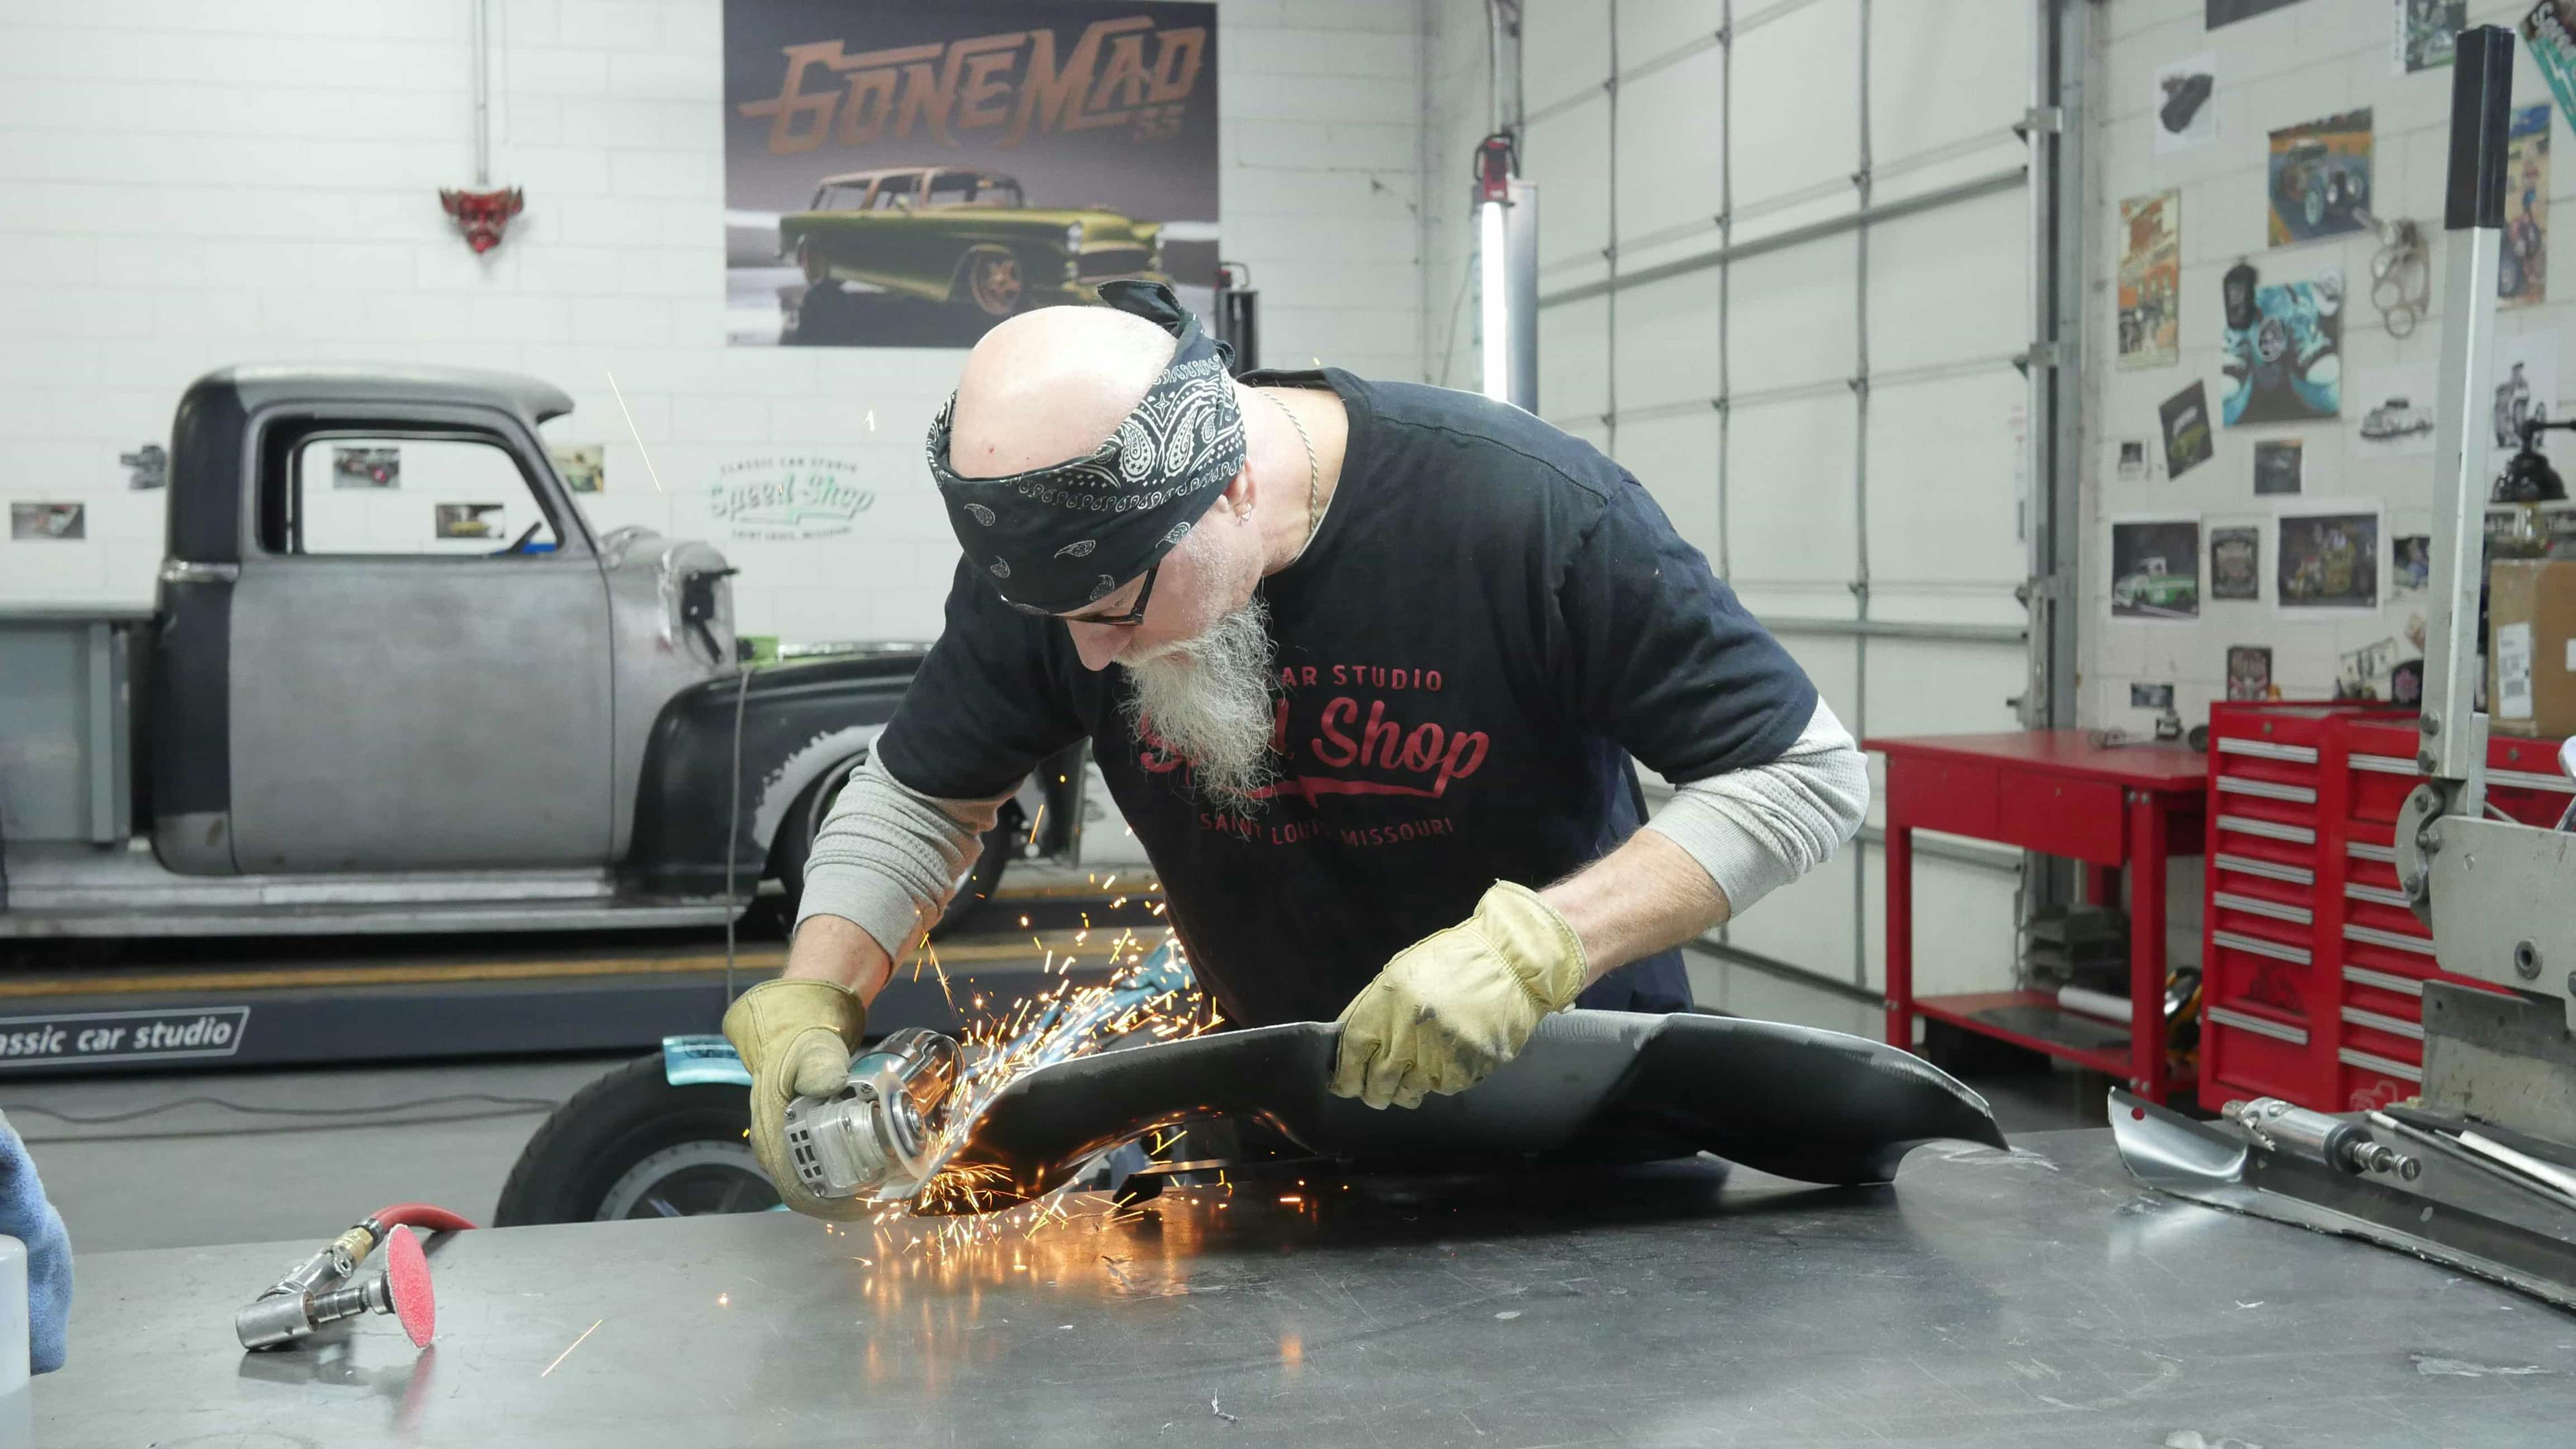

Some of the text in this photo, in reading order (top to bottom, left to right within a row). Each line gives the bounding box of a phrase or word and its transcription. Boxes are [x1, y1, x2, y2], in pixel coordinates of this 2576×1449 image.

[804, 474, 875, 521] Shop
[1334, 665, 1442, 692] STUDIO
[1312, 697, 1489, 798] Shop
[1199, 812, 1262, 838] SAINT
[1342, 816, 1454, 847] MISSOURI
[77, 1028, 126, 1051] car
[133, 1016, 232, 1049] studio
